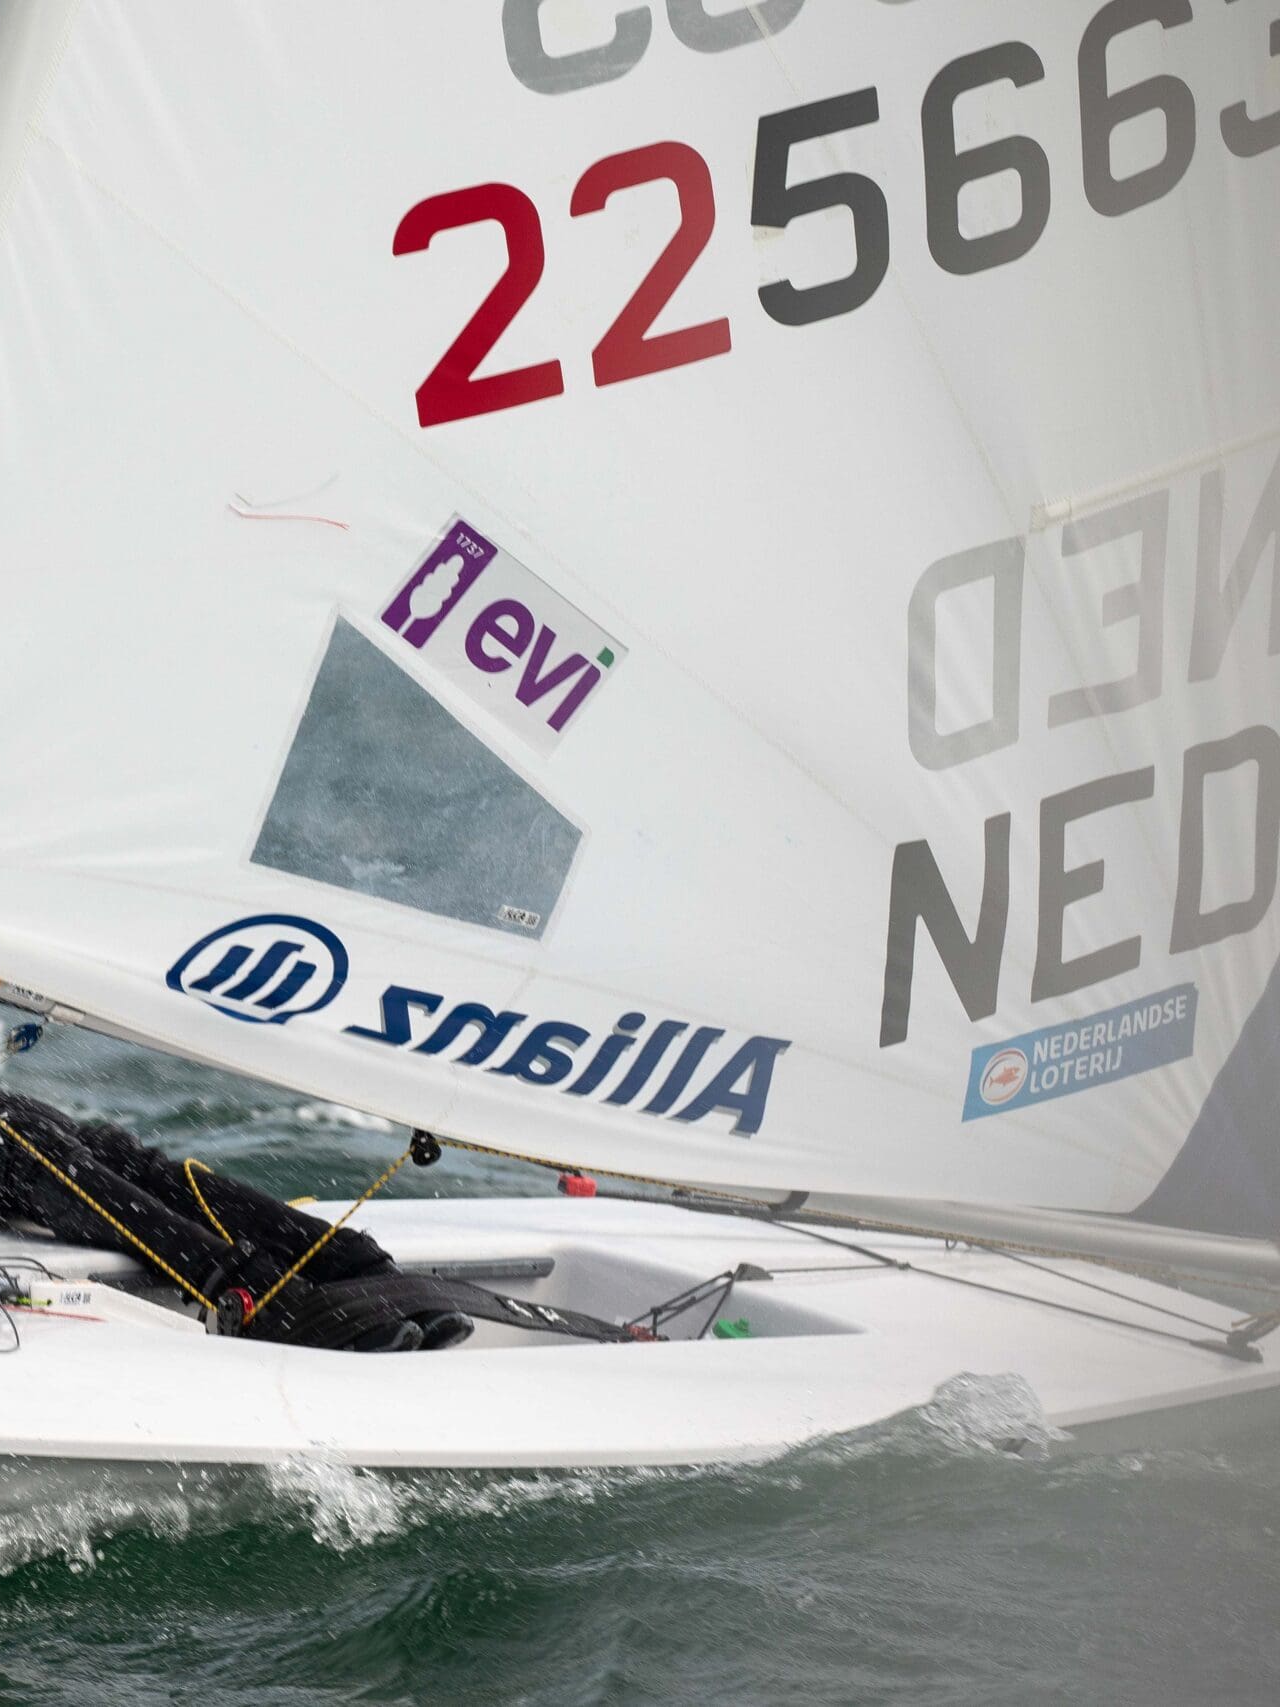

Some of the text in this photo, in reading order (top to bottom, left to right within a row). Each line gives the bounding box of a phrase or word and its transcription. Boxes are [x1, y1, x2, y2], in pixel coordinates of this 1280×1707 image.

[456, 532, 485, 559] 1737
[464, 597, 615, 733] evi
[879, 724, 1280, 1048] NED
[1032, 994, 1188, 1066] NEDERLANDSE
[1029, 1046, 1123, 1094] LOTERIJ
